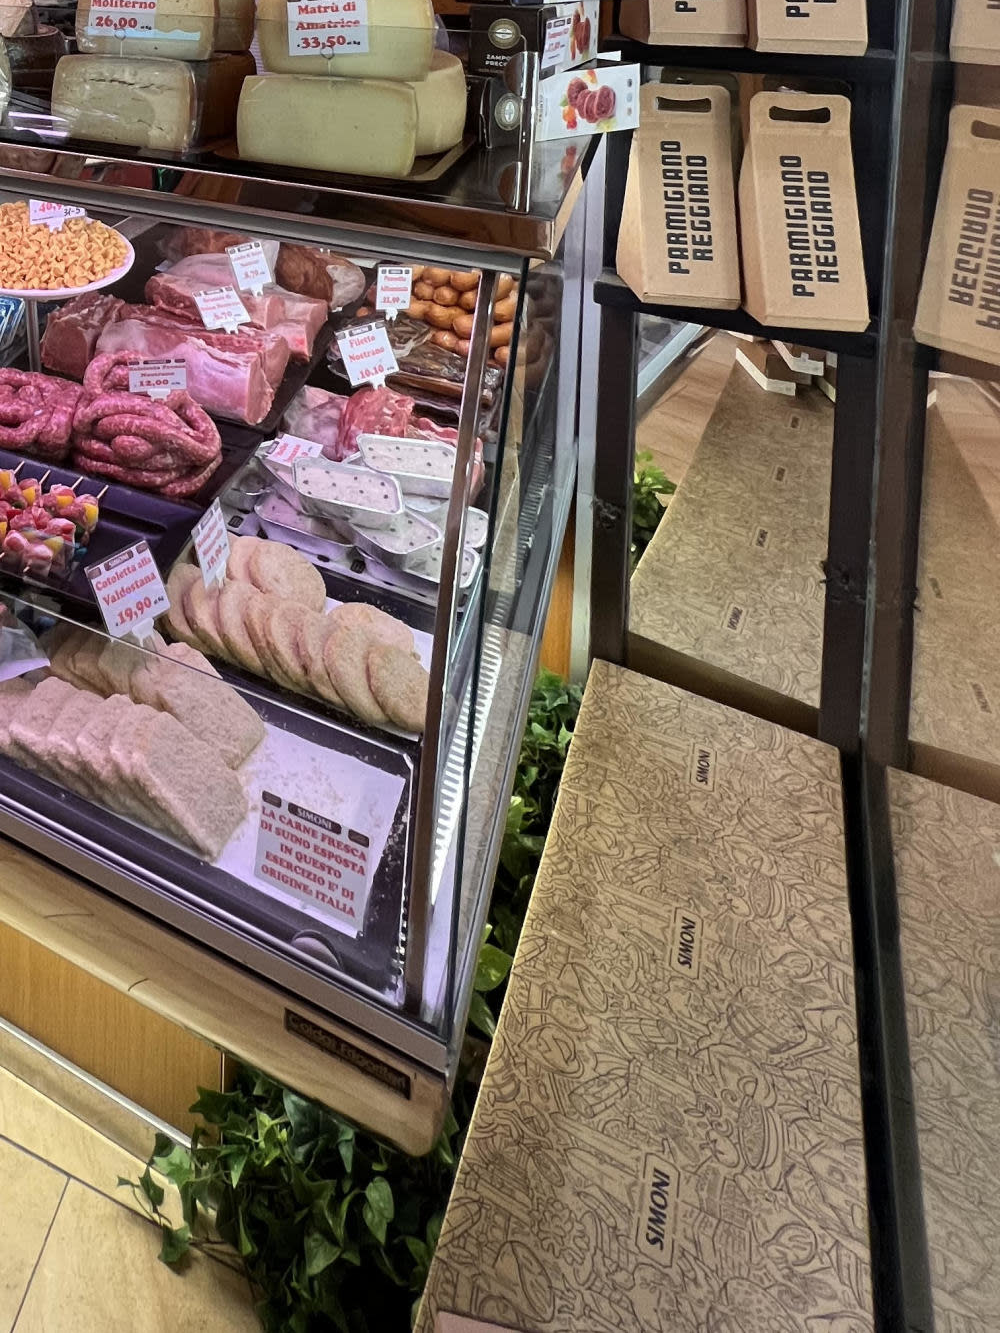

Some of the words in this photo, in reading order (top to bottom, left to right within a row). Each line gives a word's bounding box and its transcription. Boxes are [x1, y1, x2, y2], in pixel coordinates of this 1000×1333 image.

[95, 15, 138, 30] 26,00
[295, 18, 360, 30] Amatrice
[297, 2, 339, 15] Matrù
[343, 2, 356, 12] di
[301, 35, 347, 49] 33,50
[660, 140, 690, 274] PARMIGIANO
[685, 155, 714, 261] REGGIANO
[779, 155, 815, 297] PARMIGIANO
[807, 171, 840, 283] REGGIANO
[348, 347, 385, 362] Nostrano
[349, 335, 376, 348] Filetto
[95, 566, 137, 592] Cotoletta
[137, 556, 152, 569] alla
[102, 572, 156, 606] Valdostana
[117, 596, 152, 625] 19,90
[696, 749, 711, 785] SIMONI
[262, 806, 276, 820] LA
[279, 814, 318, 839] CARNE
[321, 832, 367, 862] FRESCA
[297, 807, 332, 830] SIMONI
[261, 819, 272, 832] DI
[275, 827, 310, 850] SUINO
[313, 844, 365, 876] ESPOSTA
[280, 843, 292, 855] IN
[295, 851, 342, 879] QUESTO
[265, 850, 325, 886] ESERCIZIO
[341, 887, 354, 901] DI
[315, 890, 355, 917] ITALIA
[677, 916, 697, 969] SIMONI
[645, 1167, 670, 1251] SIMONI
